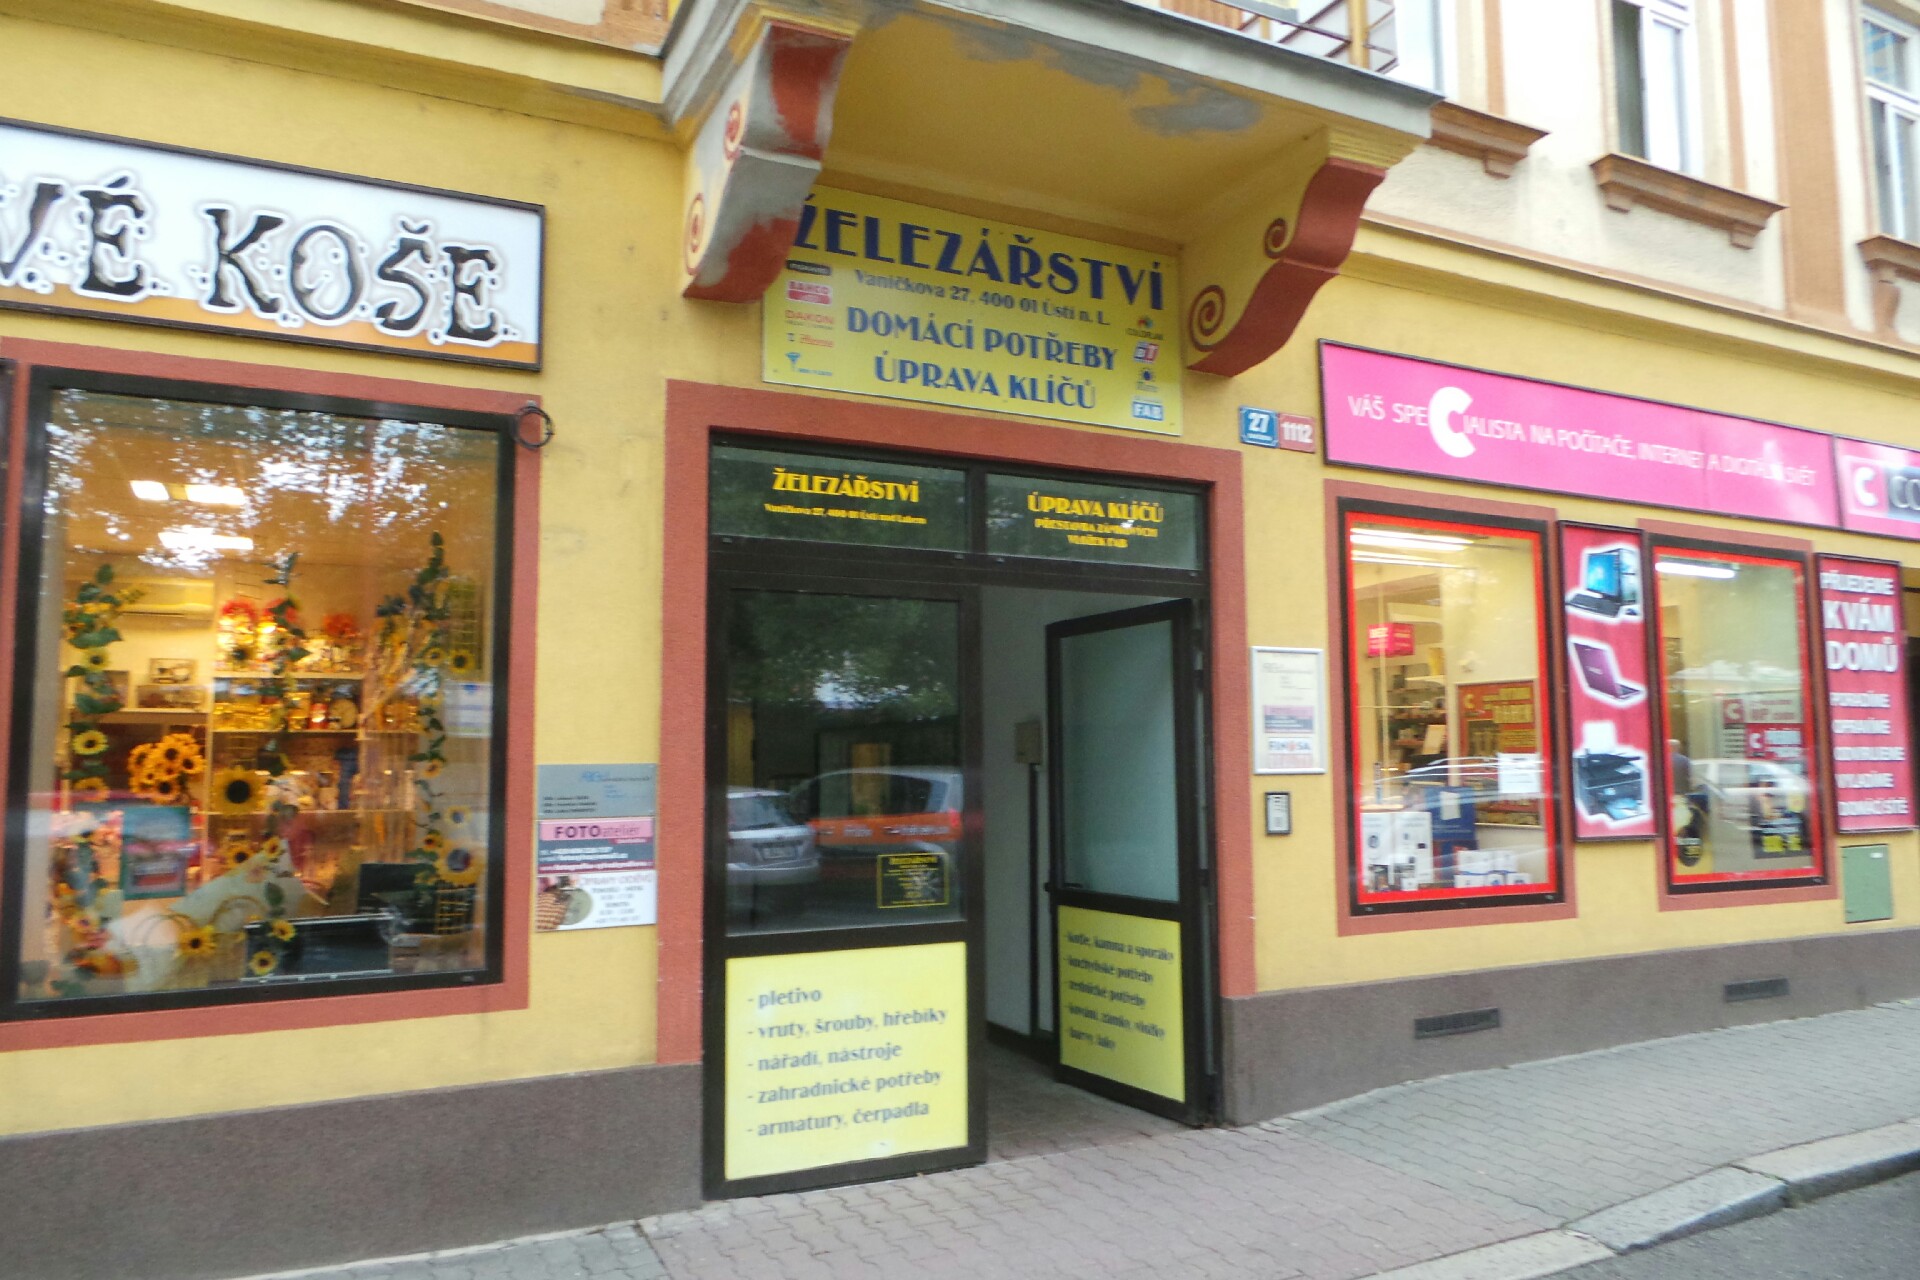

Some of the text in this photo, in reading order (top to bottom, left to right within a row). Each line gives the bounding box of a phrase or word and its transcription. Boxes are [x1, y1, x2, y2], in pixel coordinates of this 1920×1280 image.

[204, 207, 500, 343] KOŠE
[979, 291, 1015, 310] 400
[1019, 297, 1039, 314] 01
[847, 306, 975, 350] DOMÁCÍ
[984, 327, 1119, 371] POTŘEBY
[874, 349, 1097, 410] ÚPRAVA KLÍČŮ
[1247, 412, 1270, 433] 27
[1281, 421, 1313, 444] 1112
[1347, 393, 1386, 421] VÁŠ
[1530, 424, 1557, 447] NA
[1638, 442, 1705, 470] INTERNET
[772, 467, 919, 503] ŽELEZÁŘSTVÍ
[1027, 490, 1164, 523] ÚPRAVA KLÍČŮ
[1823, 597, 1895, 633] K VÁM
[1825, 636, 1898, 673] DOMŮ
[757, 987, 822, 1009] pletivo
[758, 1022, 811, 1039] vruty,
[814, 1014, 879, 1035] šrouby,
[882, 1008, 947, 1028] hřebíky
[828, 1042, 902, 1065] nástroje
[757, 1077, 871, 1104] zahradnické
[875, 1069, 942, 1093] potřeby
[757, 1112, 848, 1137] armatury,
[852, 1101, 930, 1125] čerpadla
